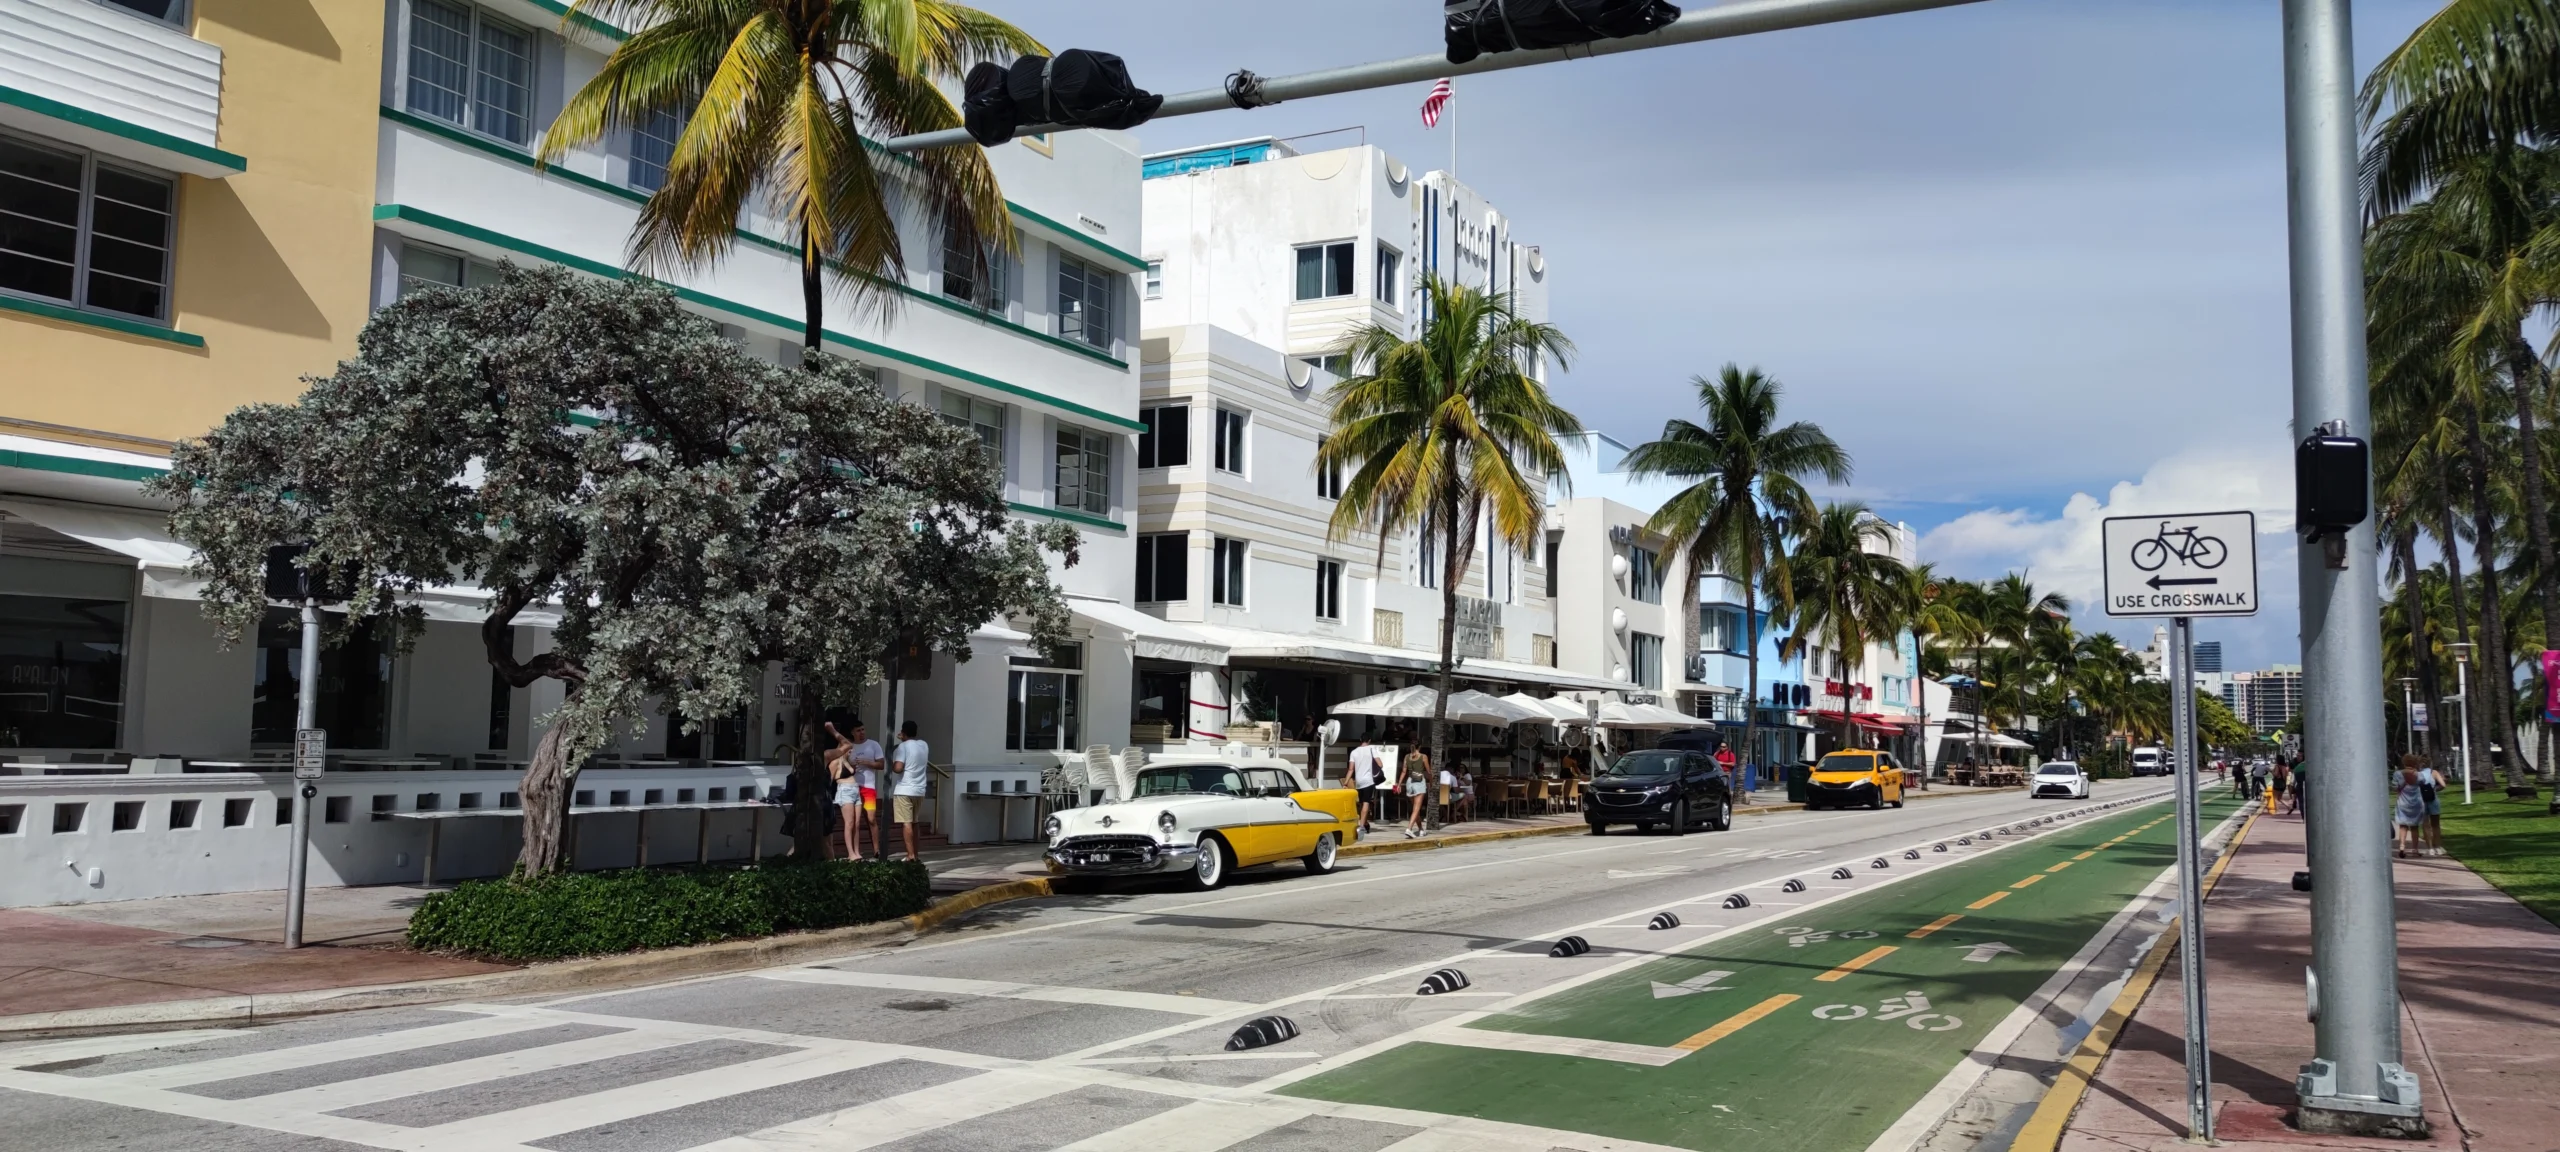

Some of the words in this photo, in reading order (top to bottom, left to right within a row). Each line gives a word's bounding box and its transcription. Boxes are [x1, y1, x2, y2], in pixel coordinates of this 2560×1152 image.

[2116, 595, 2145, 608] USE
[2151, 592, 2247, 607] CROSSWALK
[1456, 625, 1493, 649] HOTEL
[12, 664, 70, 685] AVALON
[1635, 695, 1653, 704] CVS
